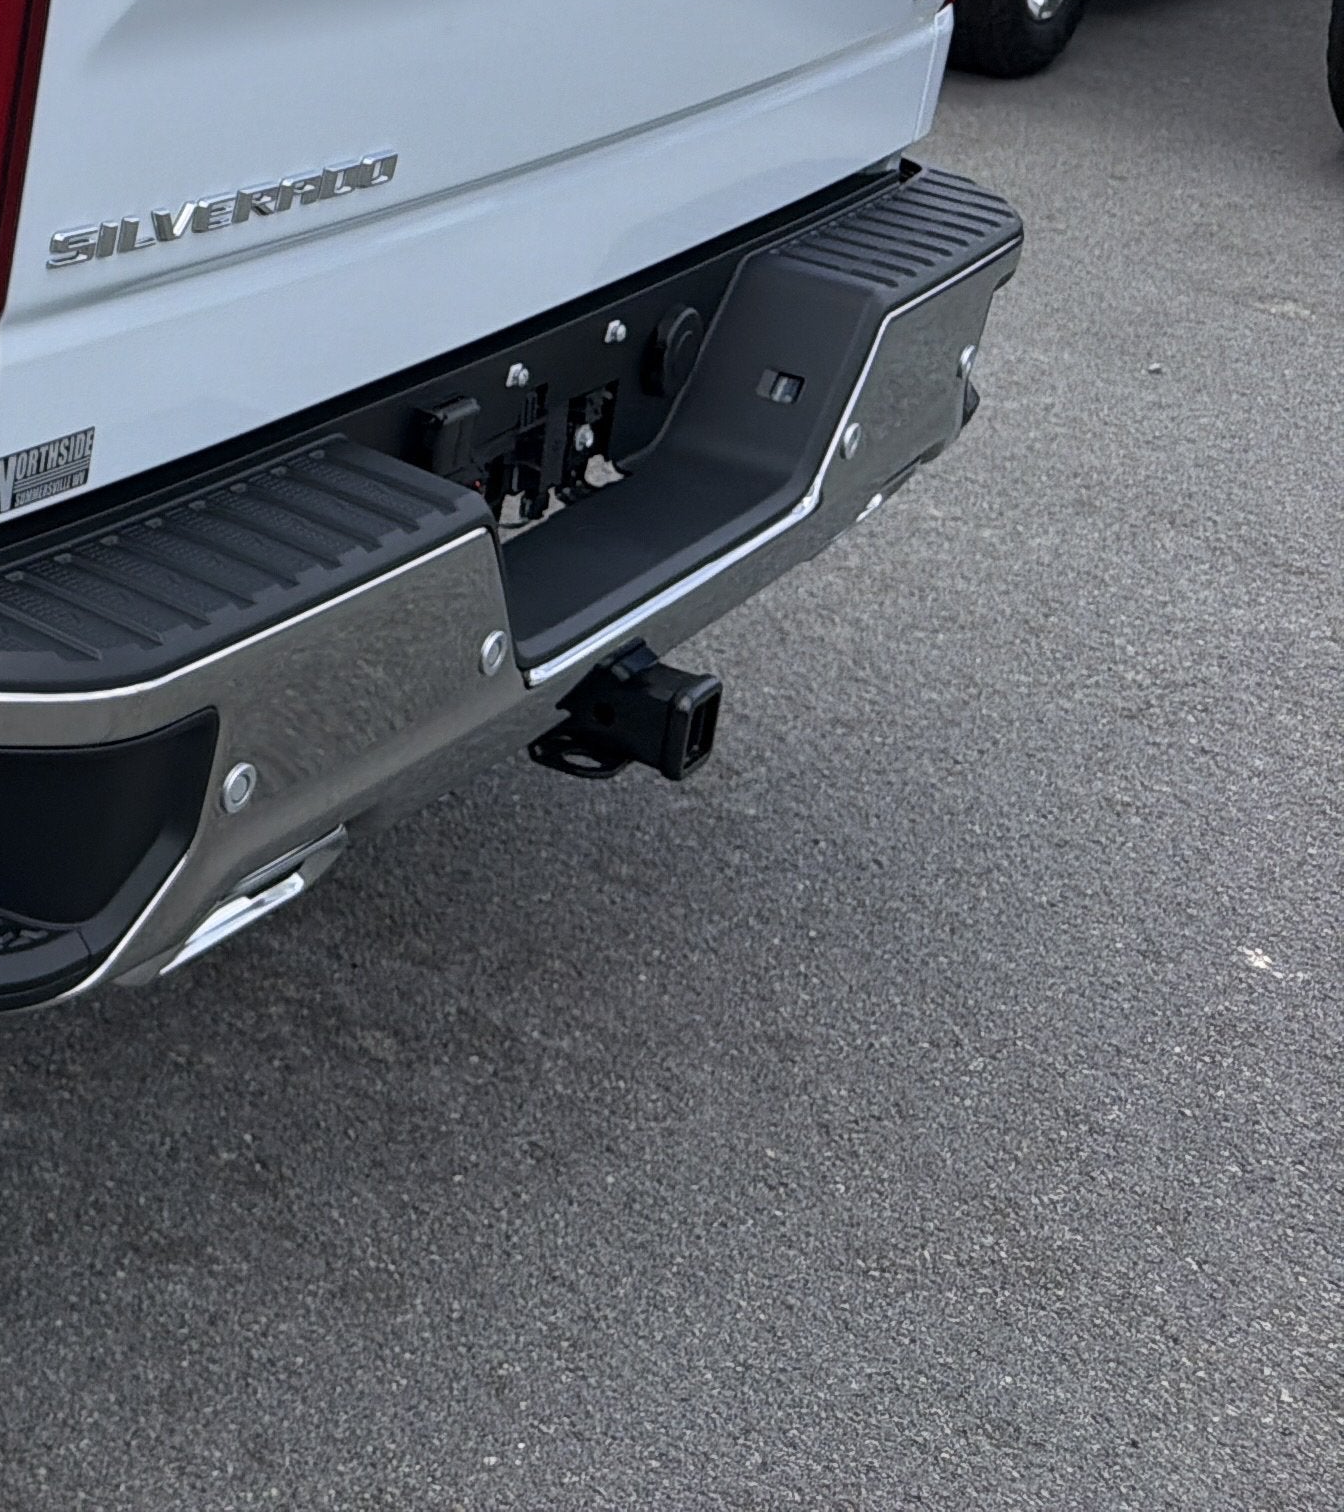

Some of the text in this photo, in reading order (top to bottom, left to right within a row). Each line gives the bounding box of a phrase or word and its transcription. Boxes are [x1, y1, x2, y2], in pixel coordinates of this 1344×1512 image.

[46, 148, 399, 269] SILVERADO
[14, 469, 85, 507] SUMMERSVILLE WV
